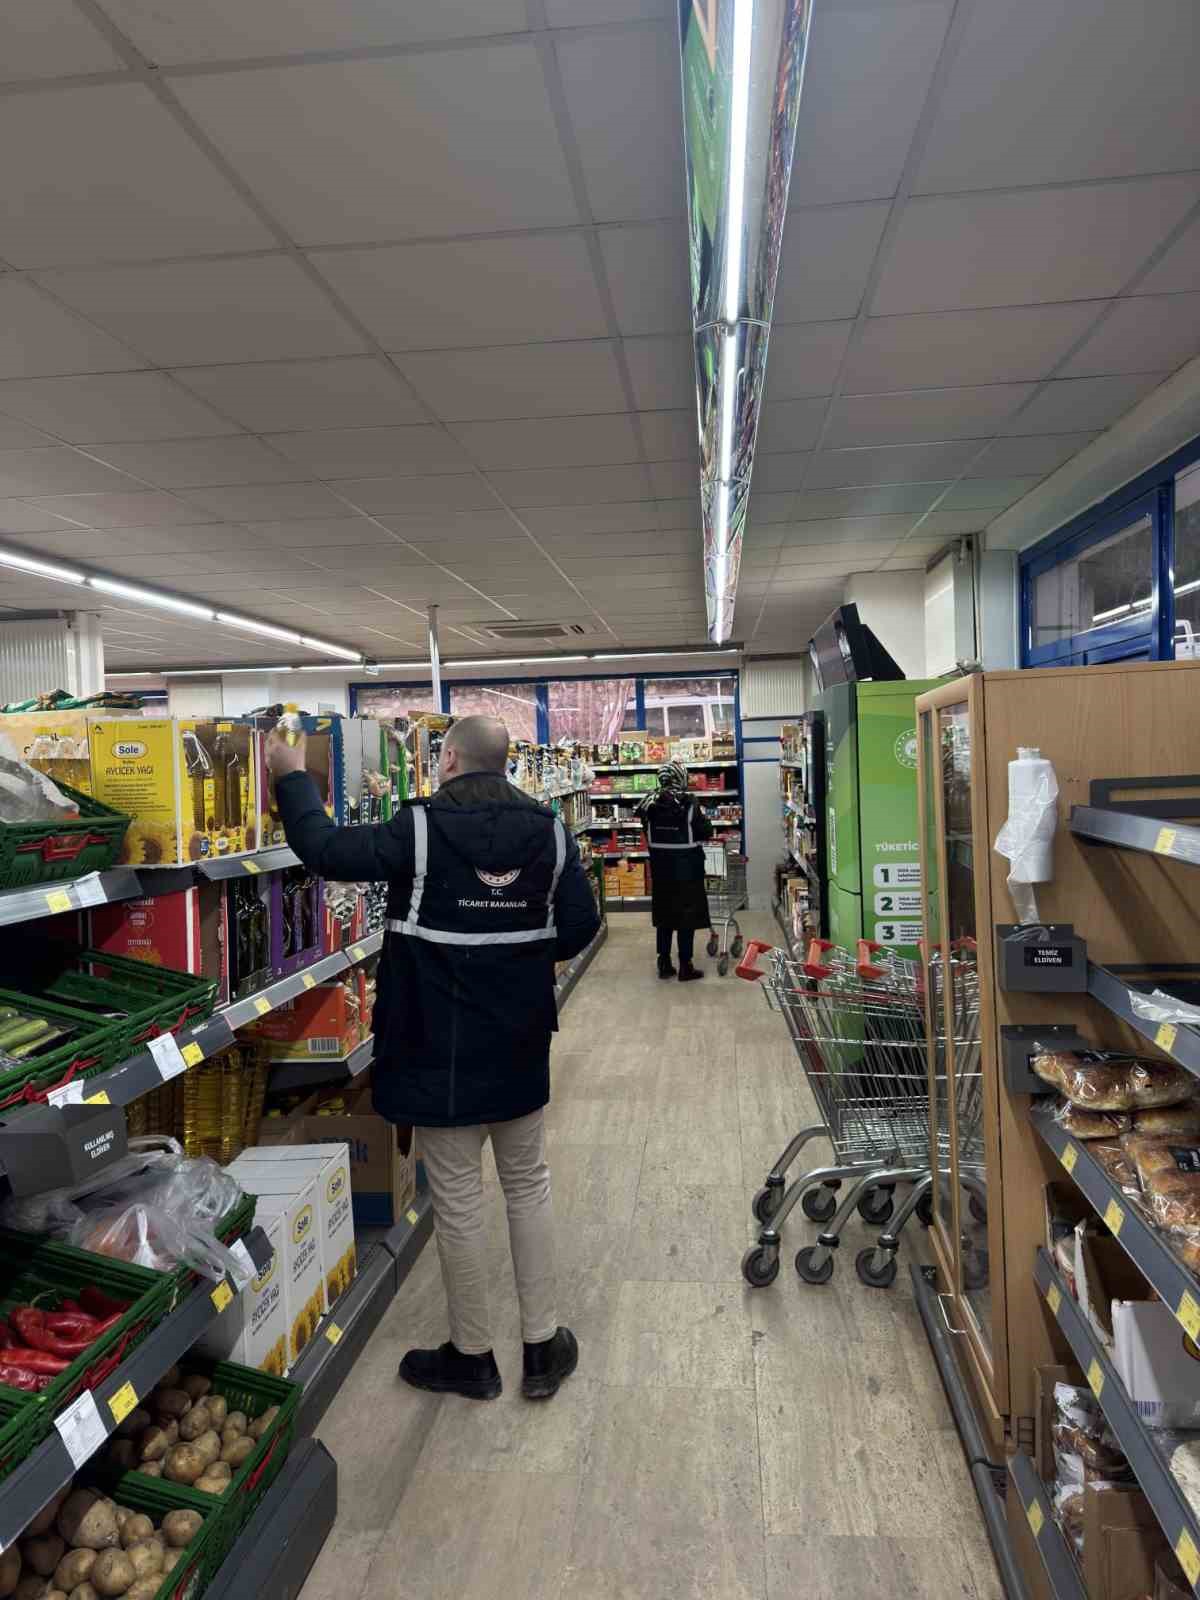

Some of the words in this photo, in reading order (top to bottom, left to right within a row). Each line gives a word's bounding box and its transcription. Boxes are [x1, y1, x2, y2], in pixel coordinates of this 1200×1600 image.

[118, 745, 139, 754] Sole
[880, 868, 890, 883] 1
[457, 898, 489, 908] TİCARET
[880, 897, 893, 911] 2
[882, 925, 895, 940] 3
